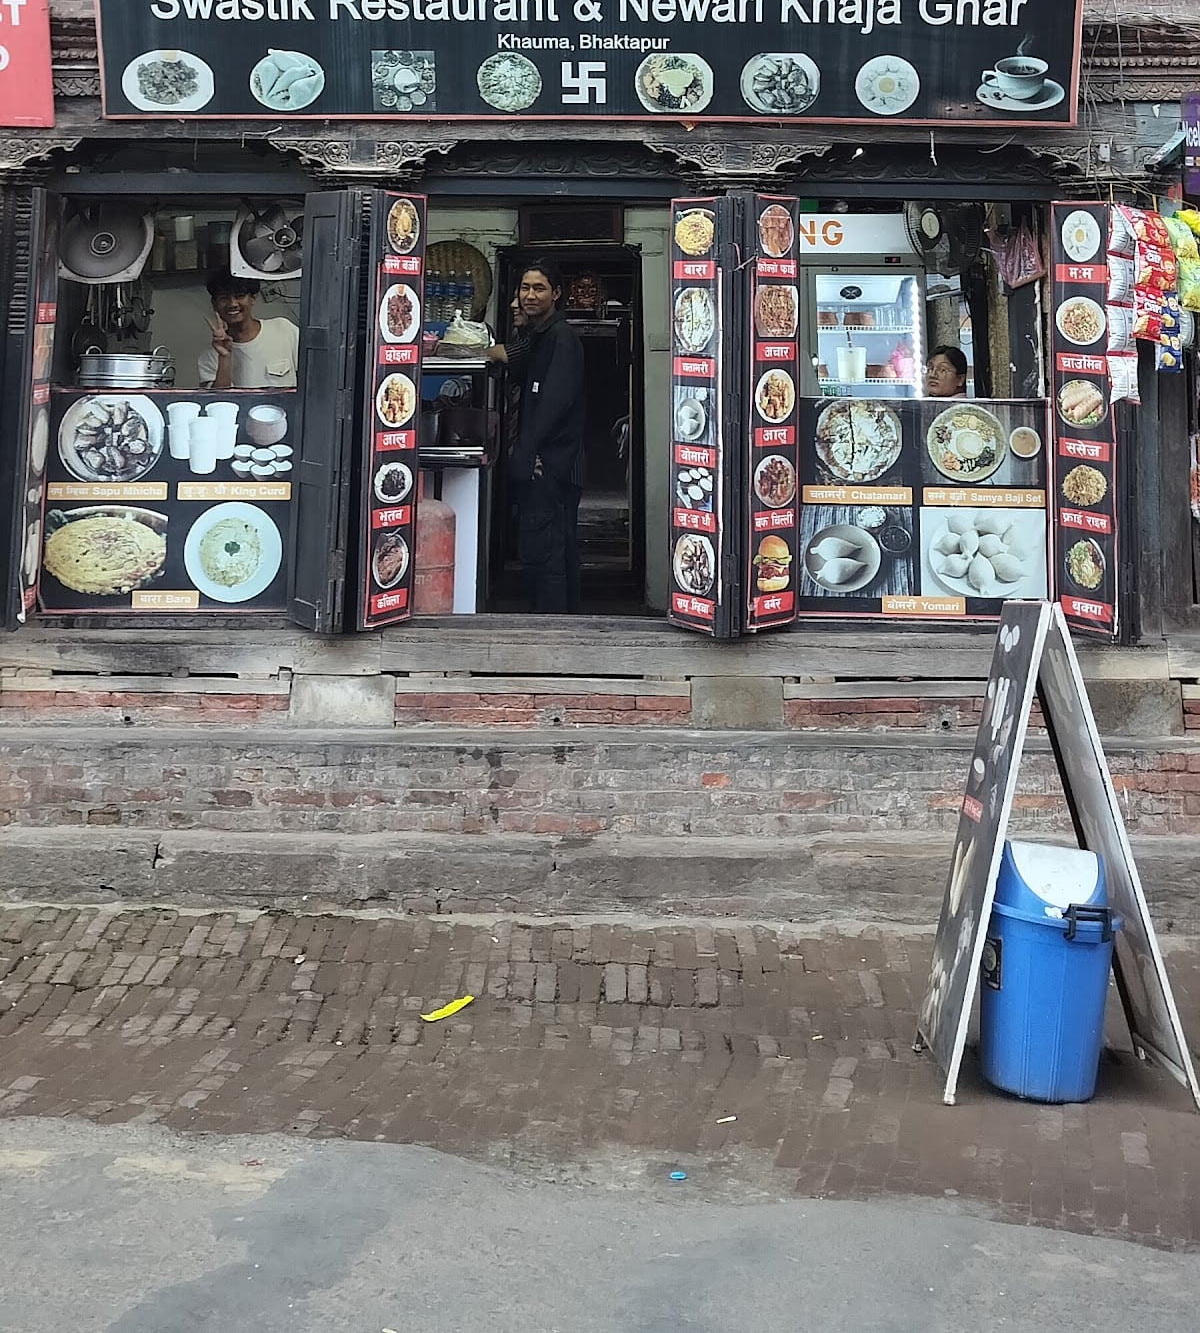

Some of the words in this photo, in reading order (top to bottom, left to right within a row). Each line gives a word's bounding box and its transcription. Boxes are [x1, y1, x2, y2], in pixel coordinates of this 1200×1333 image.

[497, 33, 576, 52] Khauma,
[579, 33, 670, 53] Bhaktapur
[92, 486, 120, 498] Sapu
[123, 486, 162, 496] Mhicha
[231, 486, 257, 498] King
[259, 486, 286, 496] Curd
[851, 490, 907, 501] Chatamari
[970, 492, 1003, 504] Samya
[1005, 493, 1024, 504] Baji
[1026, 494, 1042, 503] Set
[165, 594, 192, 604] Bara
[921, 602, 960, 611] Yomari
